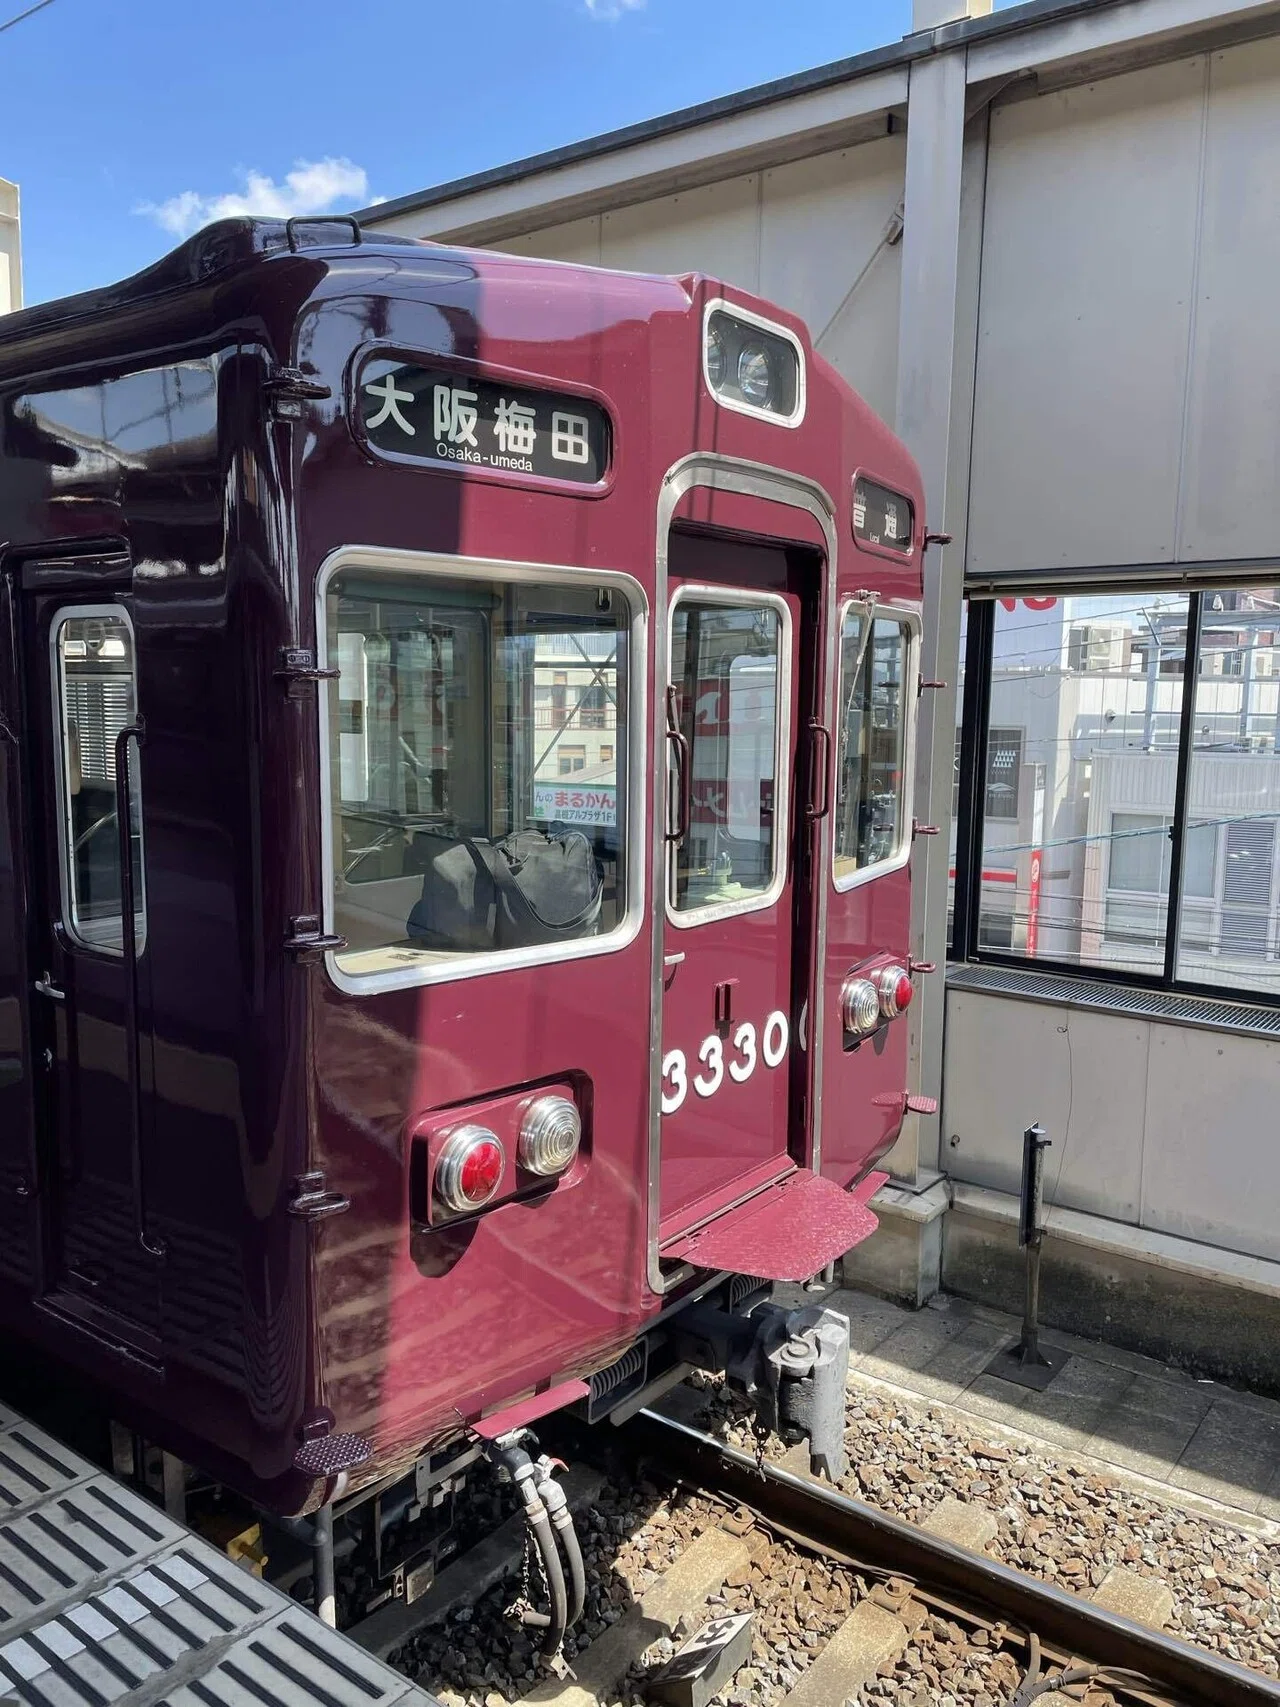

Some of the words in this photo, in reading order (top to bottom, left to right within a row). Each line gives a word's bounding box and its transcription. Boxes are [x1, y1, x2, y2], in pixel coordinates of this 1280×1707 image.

[365, 374, 589, 464] 大阪梅田
[436, 442, 533, 472] Osaka-umeda
[853, 489, 897, 539] 普通
[661, 1010, 789, 1115] 3330
